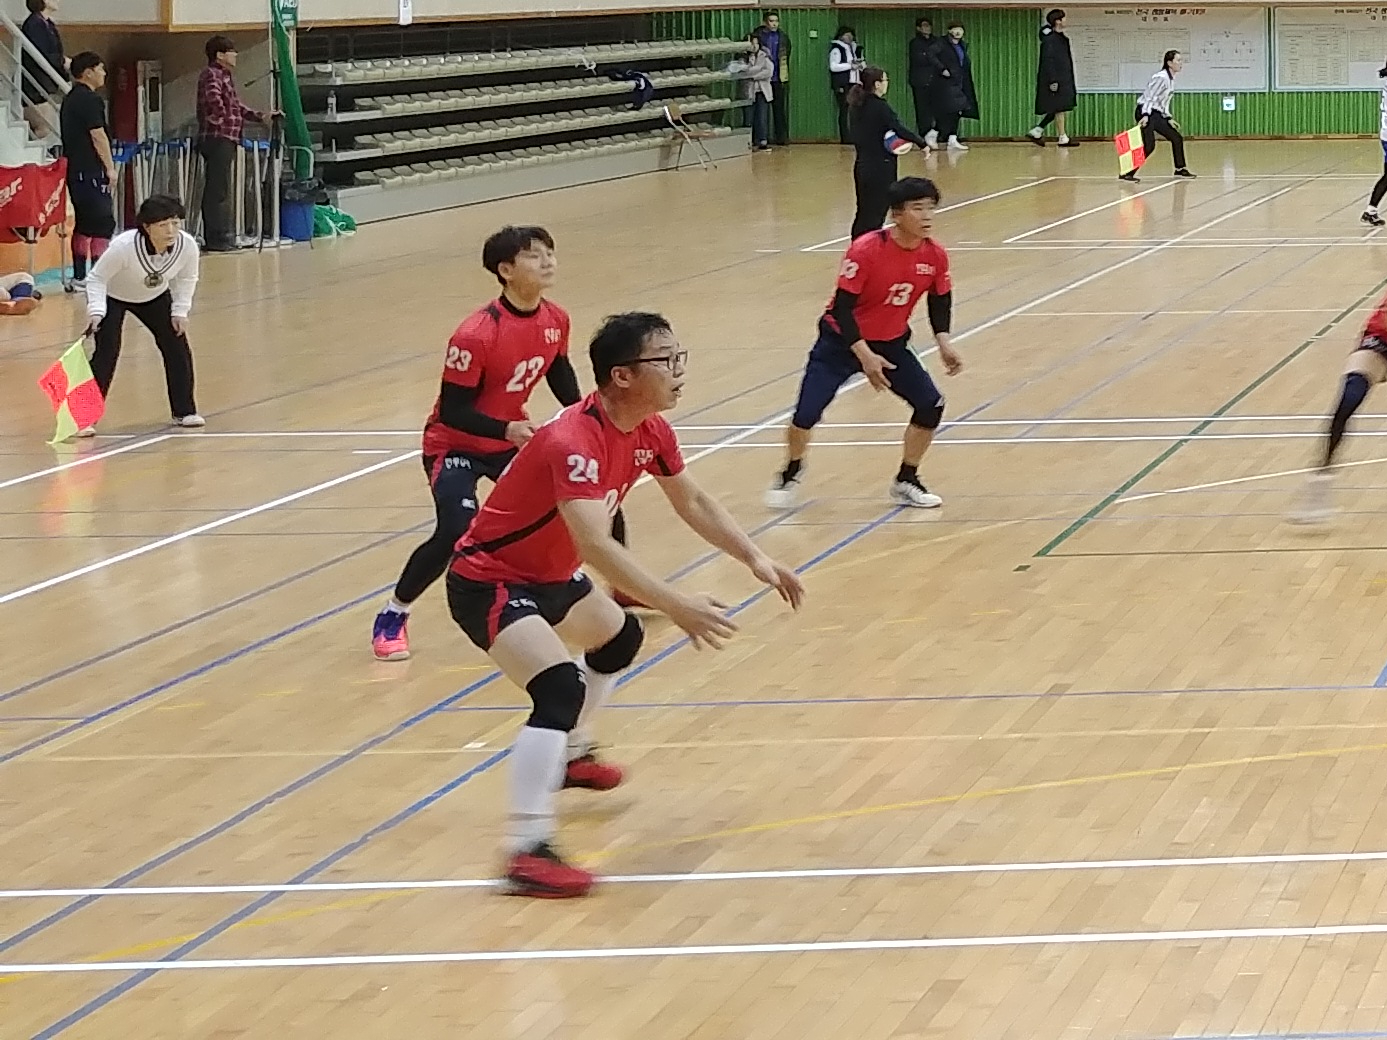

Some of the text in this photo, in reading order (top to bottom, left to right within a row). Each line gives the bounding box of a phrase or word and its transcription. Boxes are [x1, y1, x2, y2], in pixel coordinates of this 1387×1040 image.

[883, 282, 914, 306] 13
[446, 345, 473, 372] 23
[566, 454, 600, 485] 24
